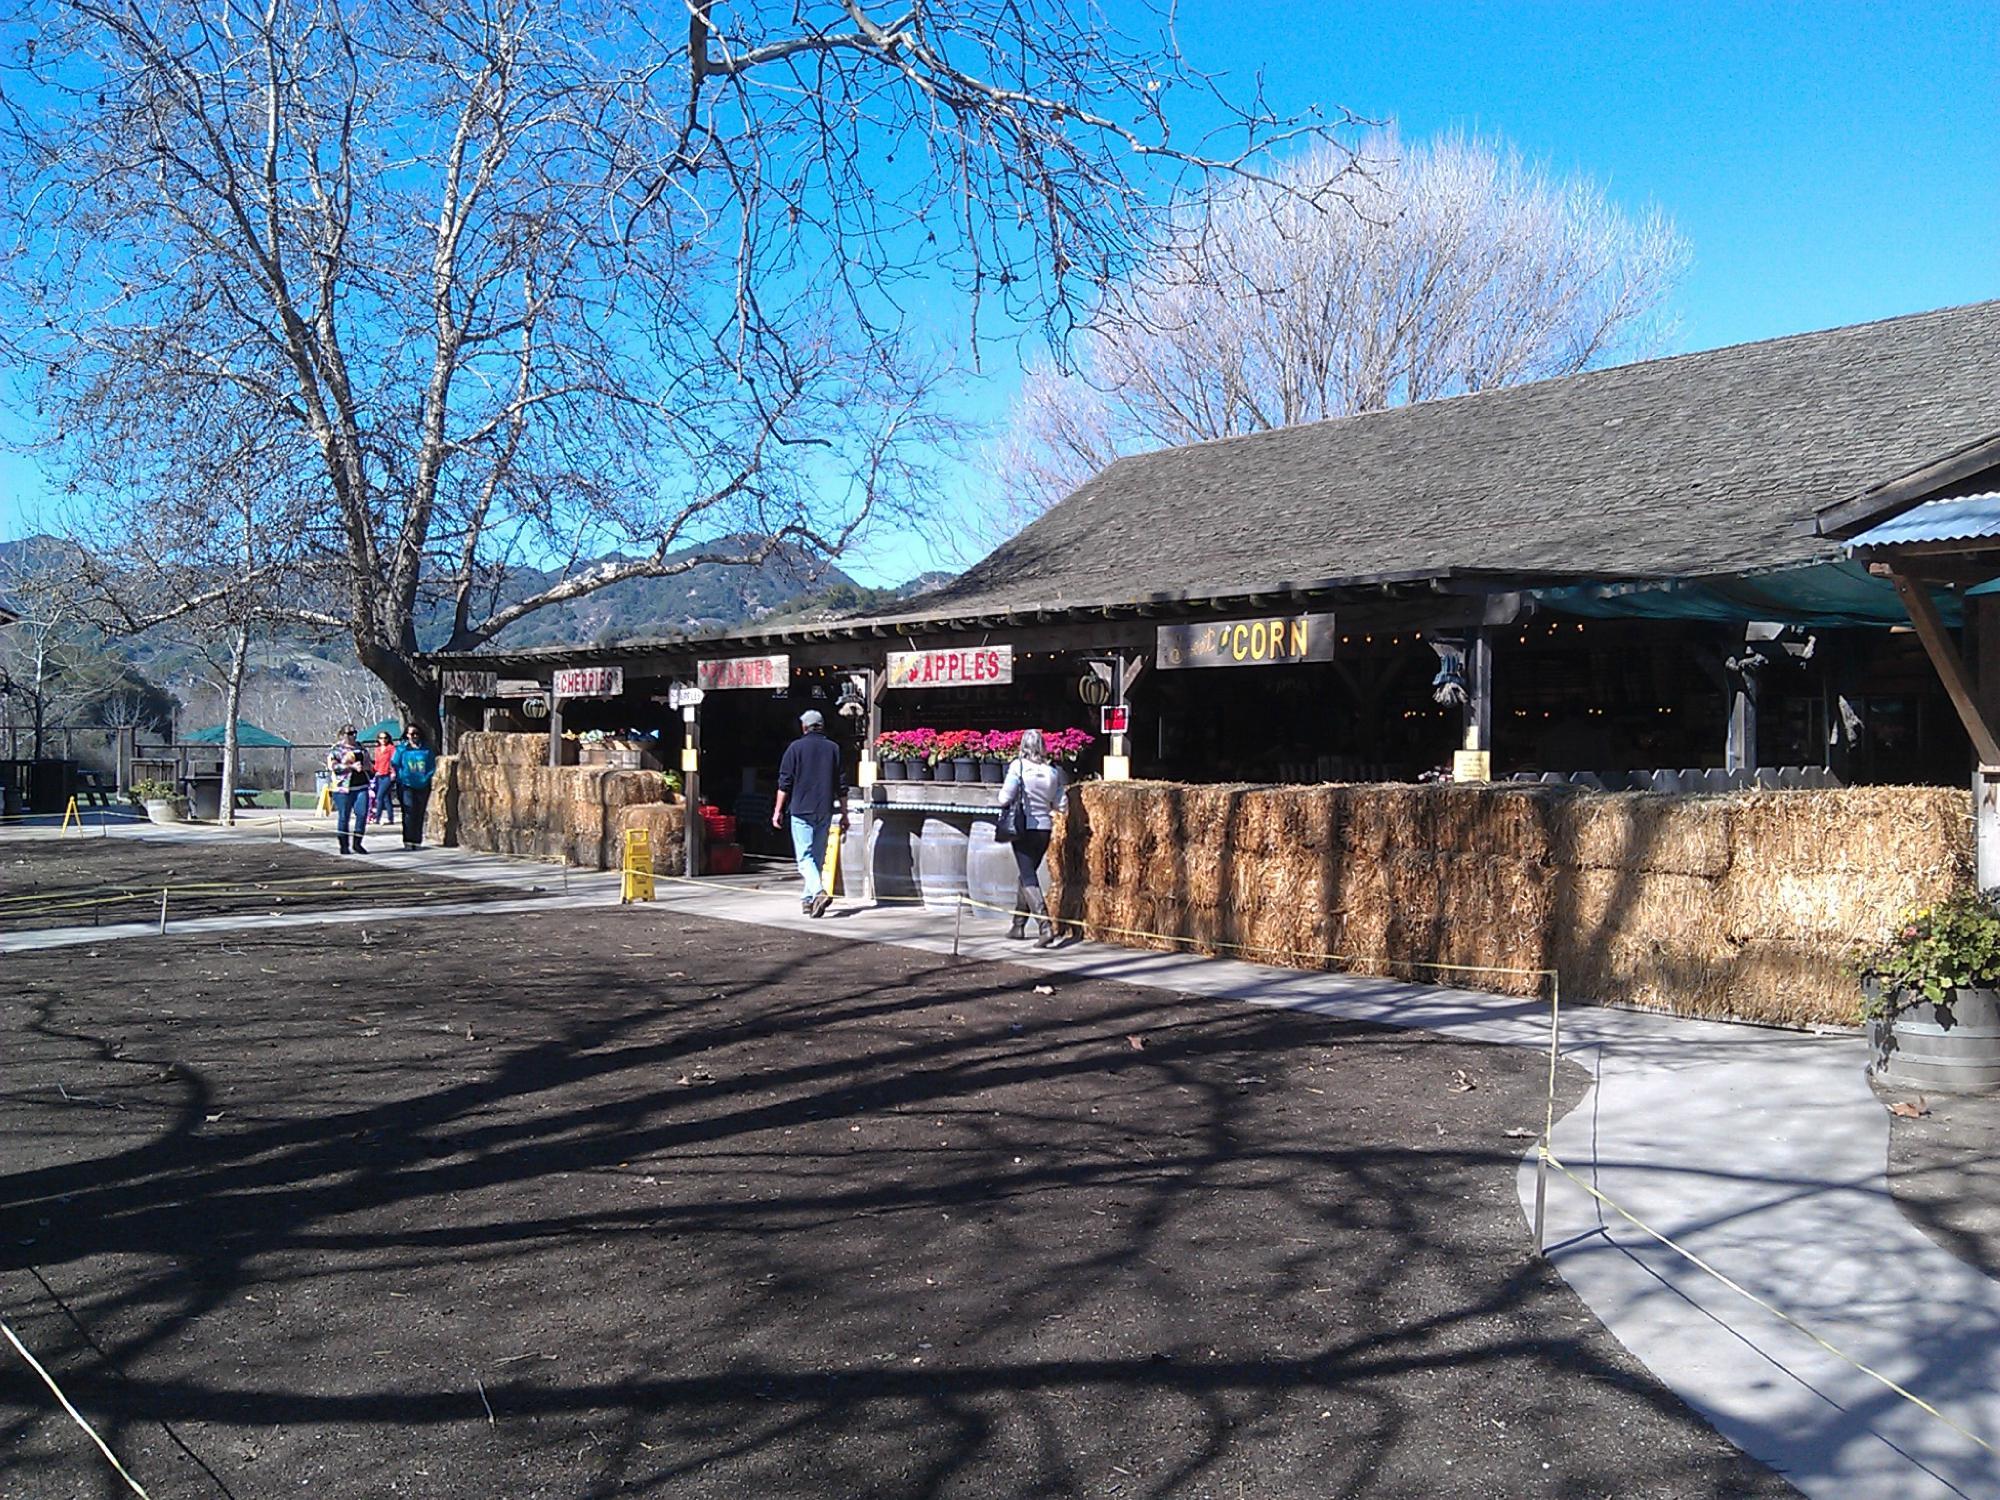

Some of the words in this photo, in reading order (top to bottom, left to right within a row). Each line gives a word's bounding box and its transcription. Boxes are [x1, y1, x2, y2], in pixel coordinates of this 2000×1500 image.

[1232, 619, 1309, 661] CORN
[923, 651, 1000, 682] APPLES
[560, 671, 613, 694] CHERRIES
